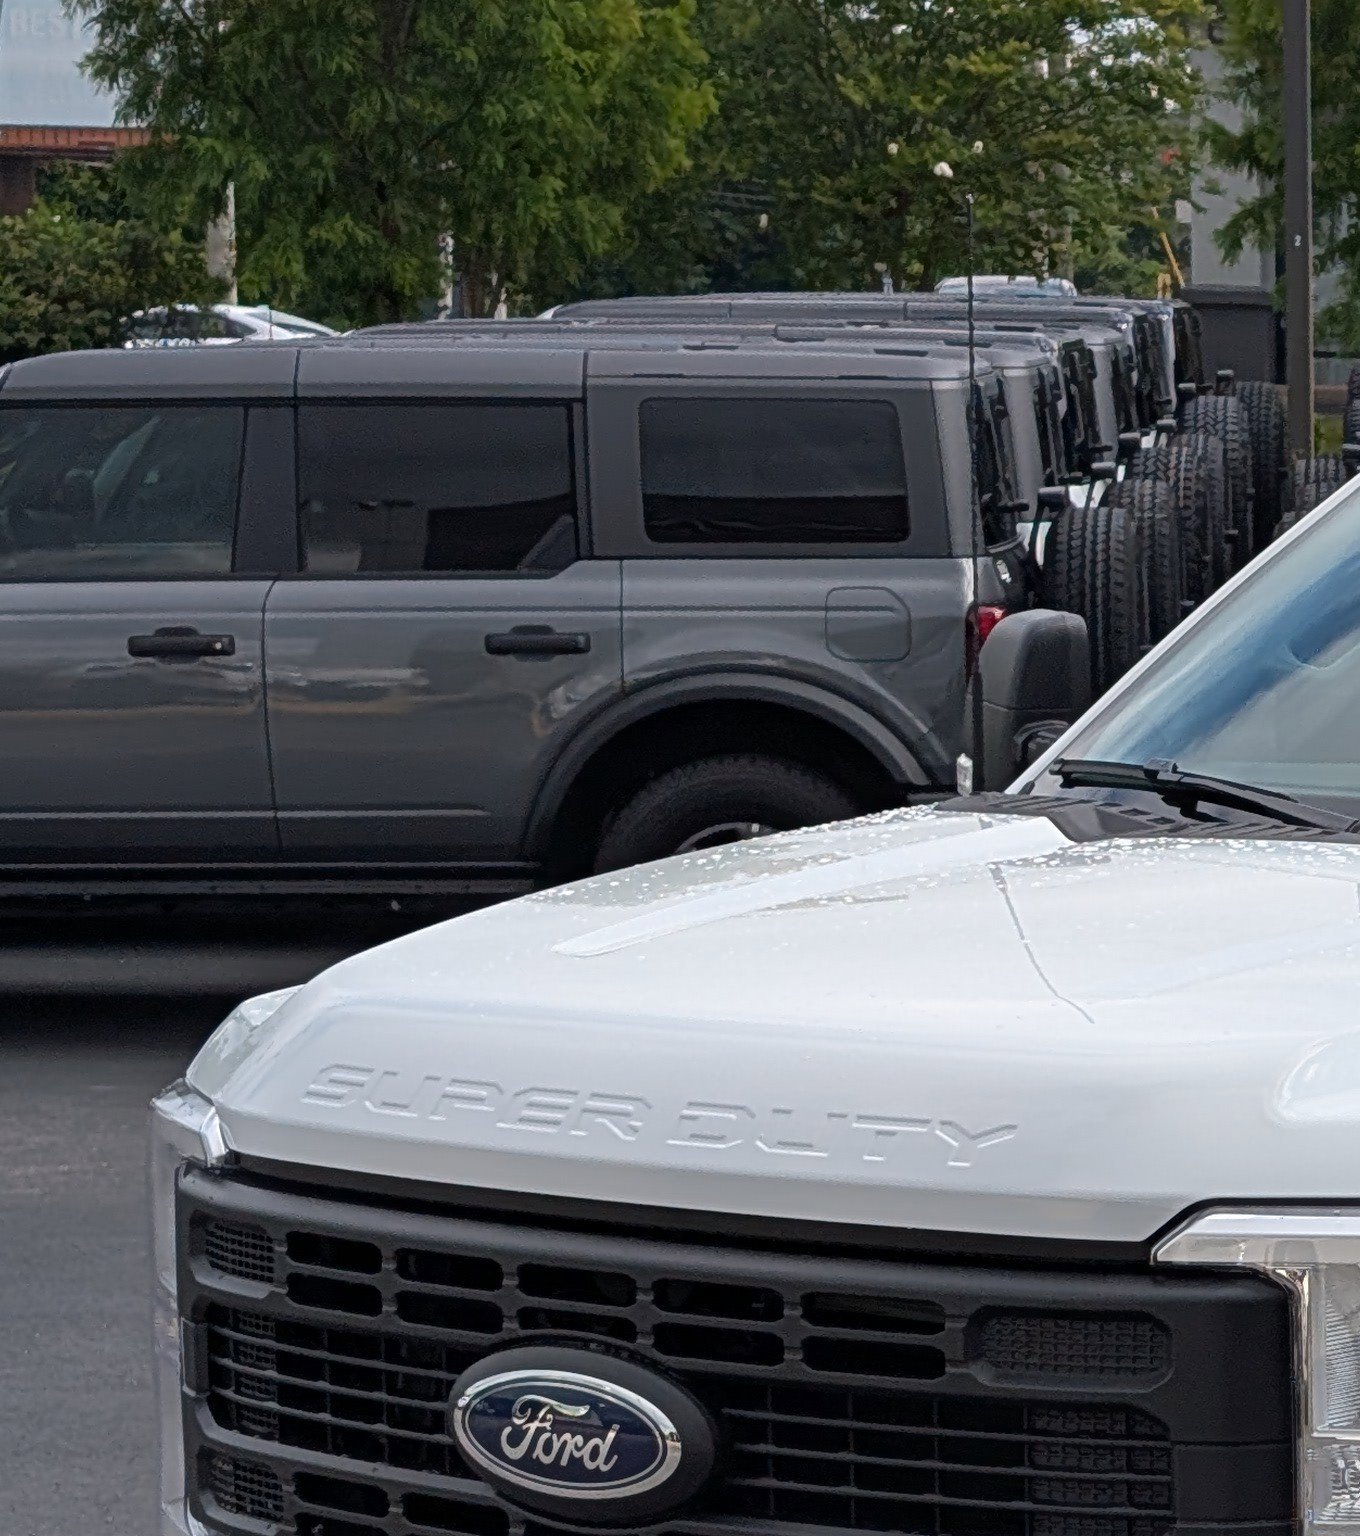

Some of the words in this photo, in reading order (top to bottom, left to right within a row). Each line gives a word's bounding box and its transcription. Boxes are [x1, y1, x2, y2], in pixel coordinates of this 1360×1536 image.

[300, 1062, 654, 1142] SUPER
[664, 1100, 1020, 1168] DUTY
[500, 1393, 622, 1473] Ford
